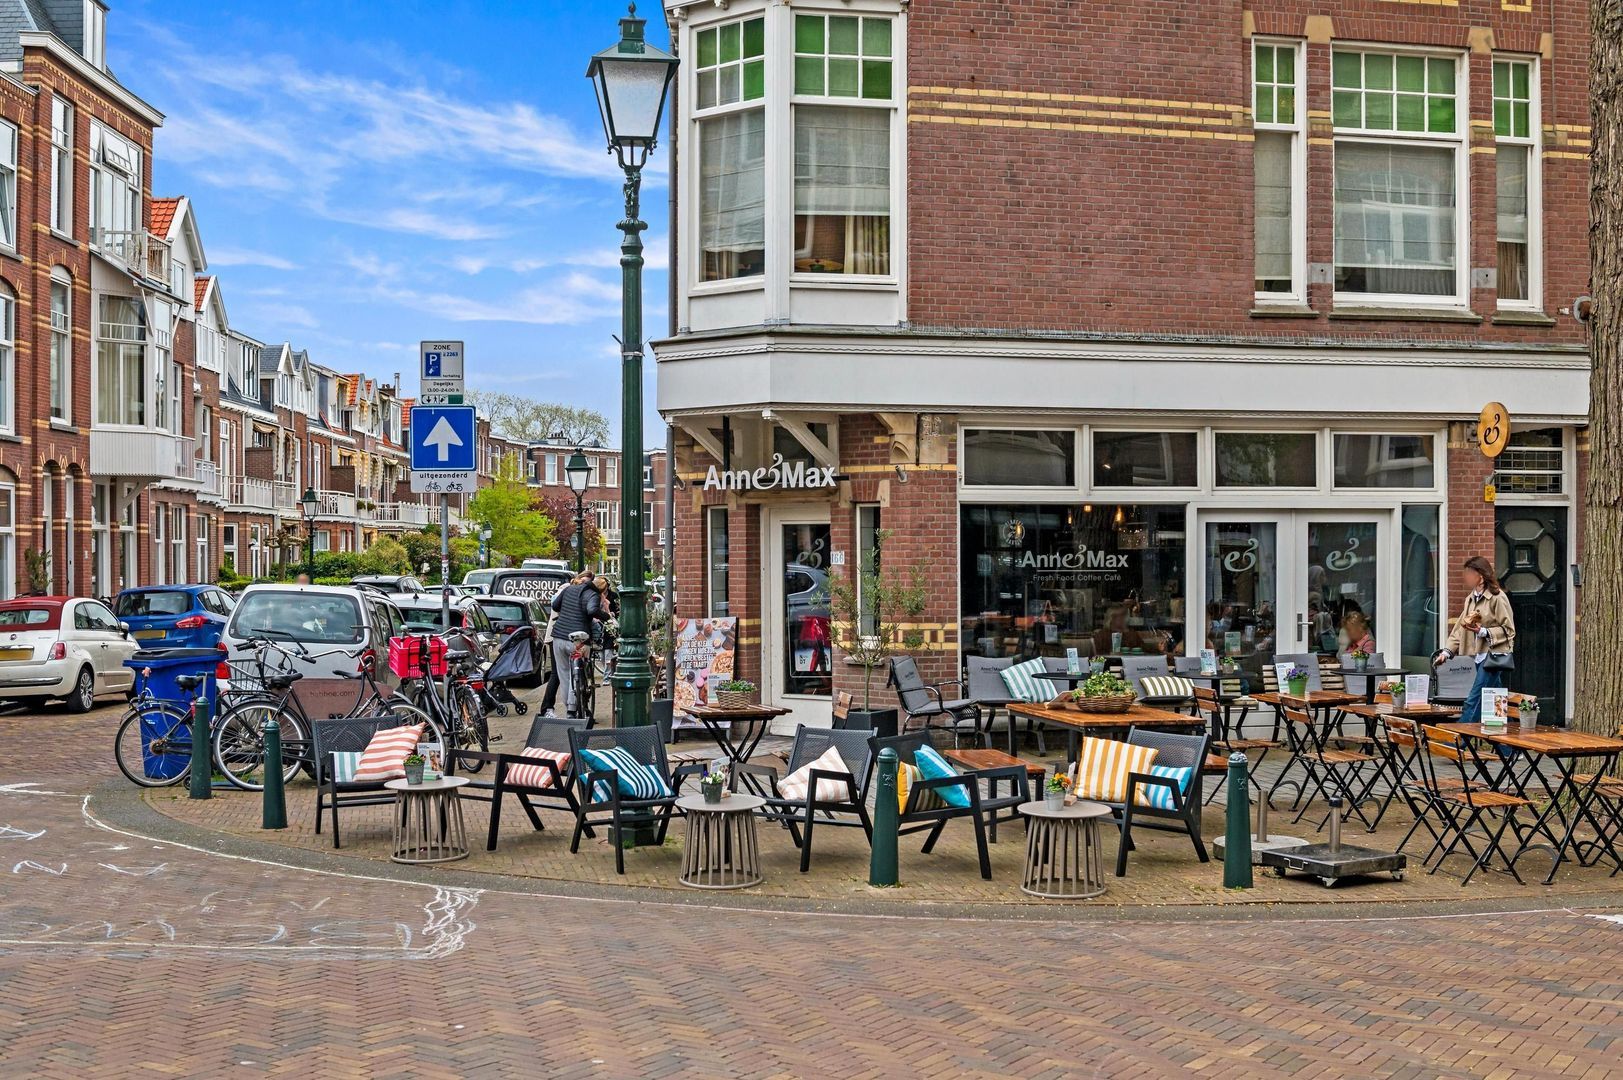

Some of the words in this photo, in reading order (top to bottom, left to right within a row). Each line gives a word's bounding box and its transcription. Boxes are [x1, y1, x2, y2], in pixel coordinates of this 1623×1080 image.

[429, 354, 438, 365] P
[419, 472, 468, 480] uitgezonderd
[629, 509, 637, 517] 64
[514, 590, 555, 600] SNACKS
